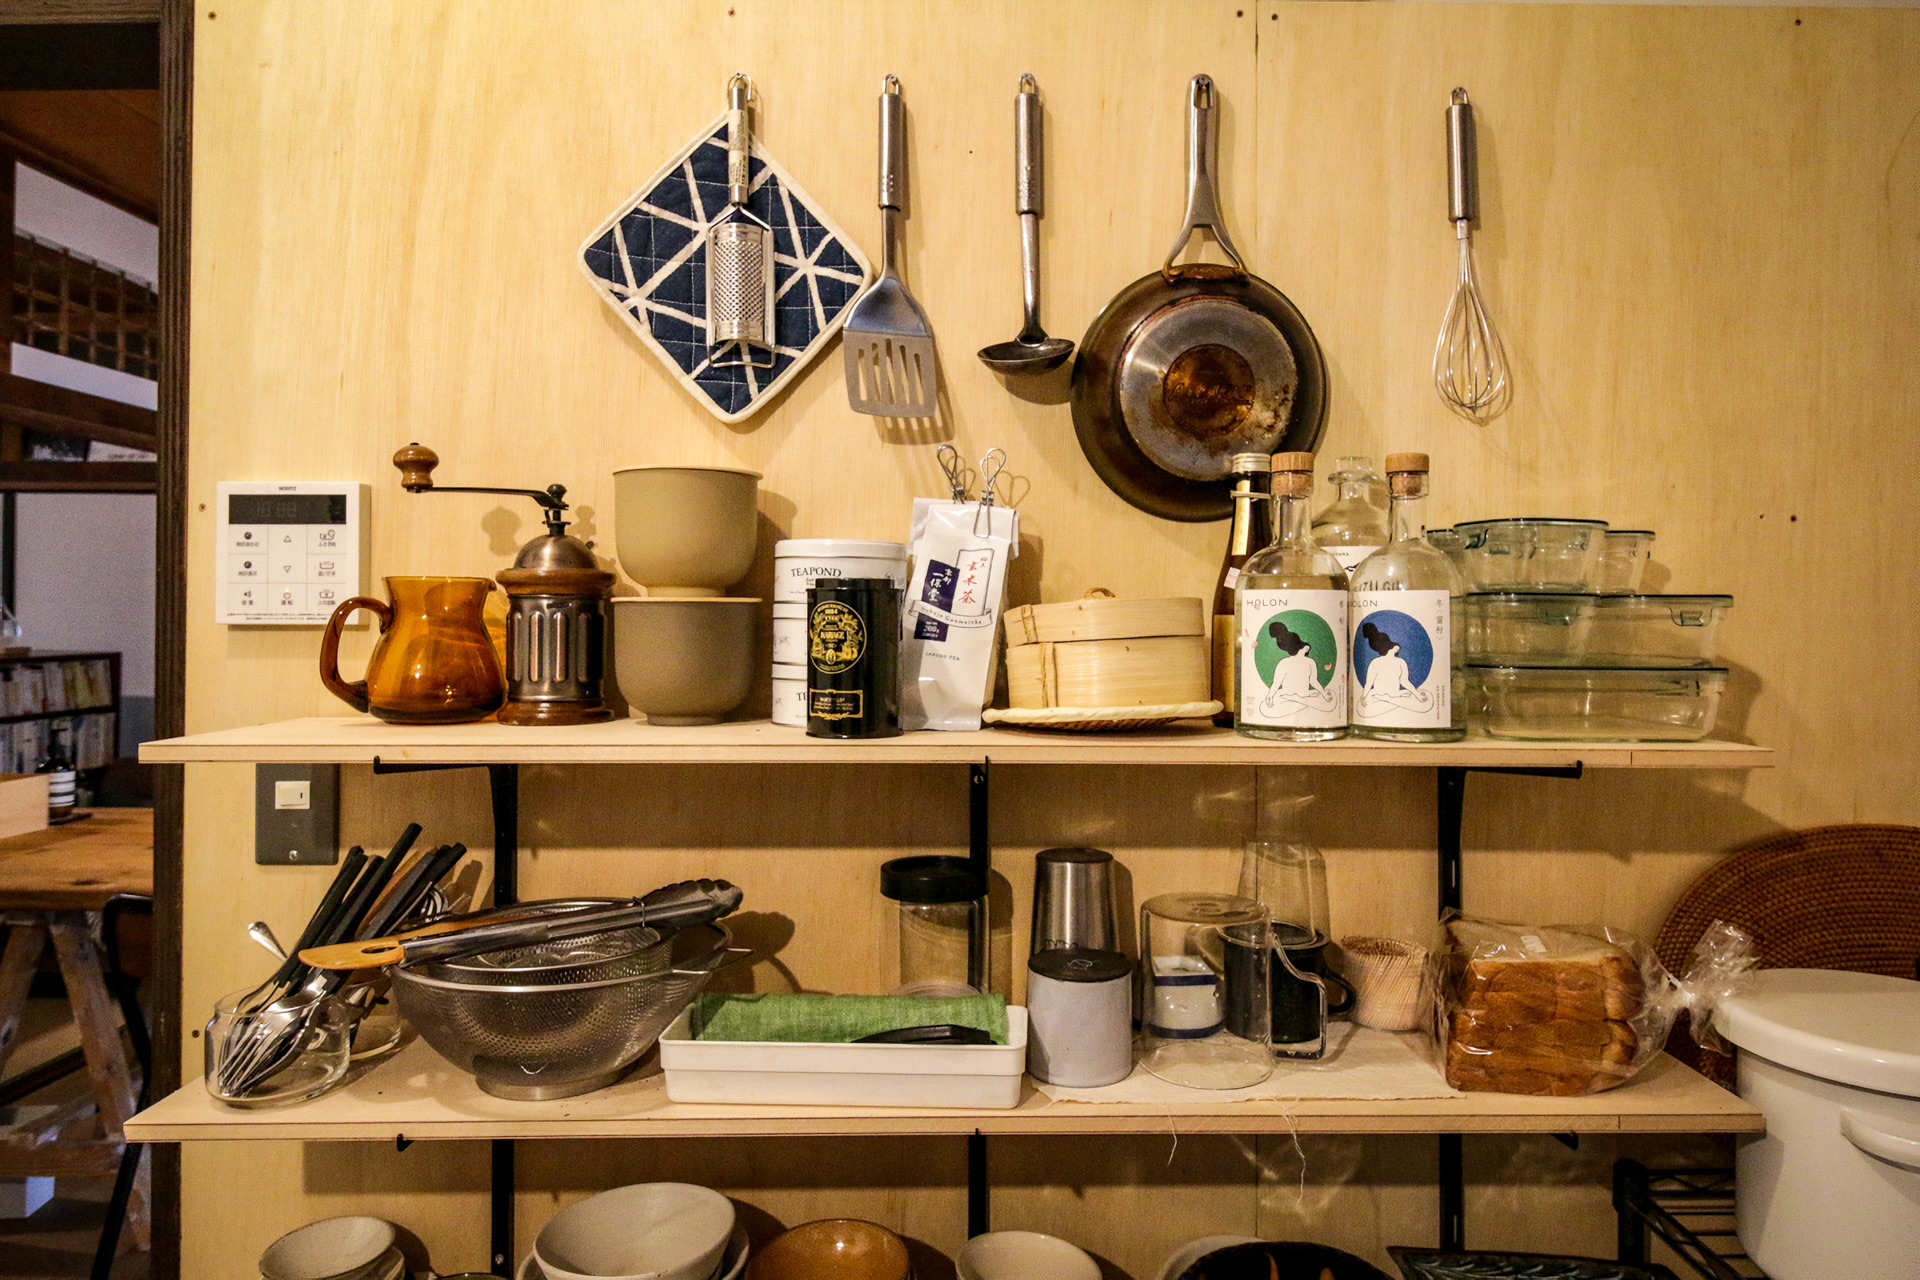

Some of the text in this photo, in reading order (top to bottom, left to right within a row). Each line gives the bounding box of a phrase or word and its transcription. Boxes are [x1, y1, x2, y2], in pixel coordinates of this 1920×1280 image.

[790, 566, 842, 578] TEAPOND
[958, 560, 980, 604] 玄米茶
[1246, 598, 1288, 607] HOLON
